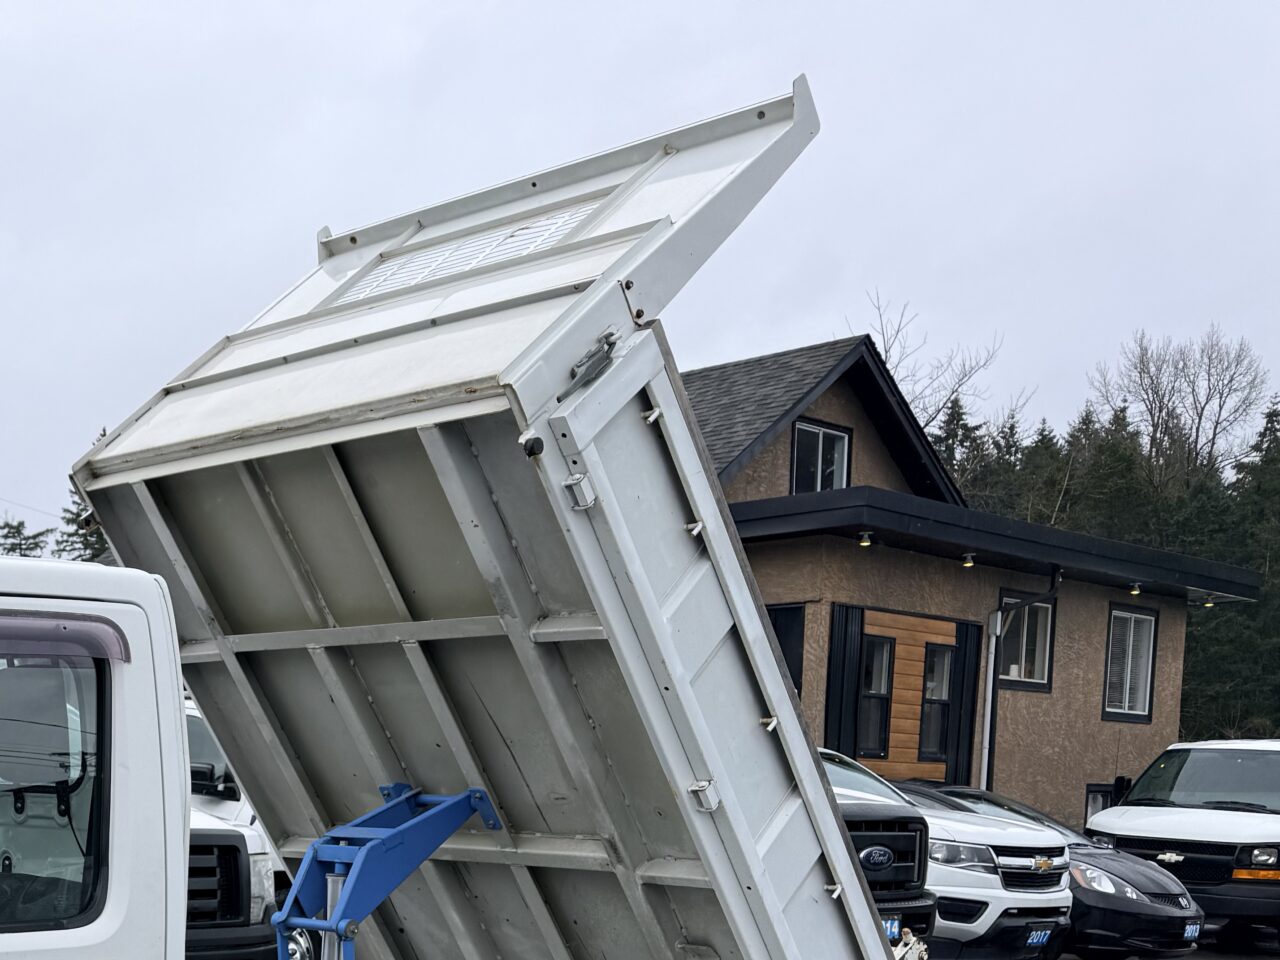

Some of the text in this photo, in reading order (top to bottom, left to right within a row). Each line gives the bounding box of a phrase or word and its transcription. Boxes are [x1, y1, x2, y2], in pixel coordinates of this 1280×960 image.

[870, 850, 889, 863] Ford
[882, 920, 899, 936] 14
[1027, 930, 1051, 943] 2017
